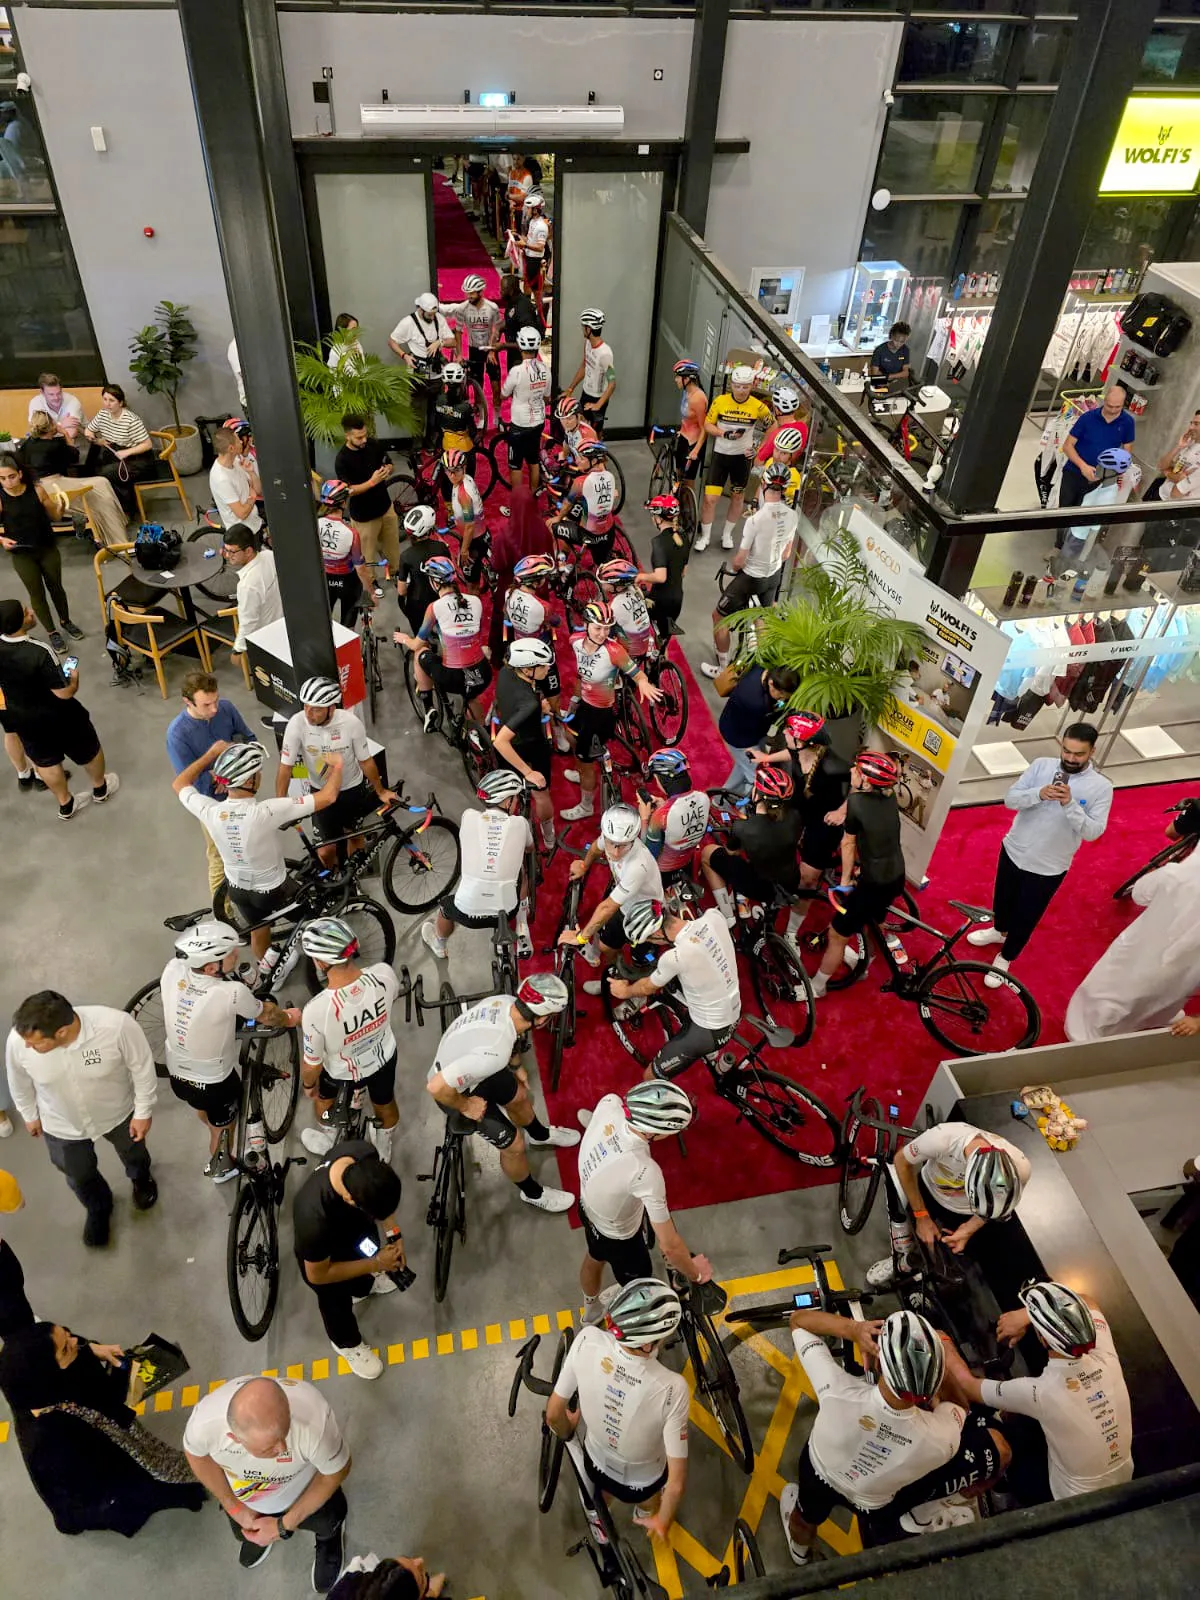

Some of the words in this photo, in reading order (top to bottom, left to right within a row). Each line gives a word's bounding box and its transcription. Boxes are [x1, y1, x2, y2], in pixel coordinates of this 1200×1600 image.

[1125, 148, 1192, 164] WOLFI'S
[468, 316, 488, 325] UAE
[529, 371, 547, 382] UAE
[594, 481, 611, 493] UAE
[868, 569, 903, 606] ANALYSIS
[940, 607, 978, 641] WOLFI'S
[681, 805, 705, 826] UAE
[356, 840, 385, 876] OLNAGO
[343, 996, 387, 1035] UAE
[82, 1049, 101, 1058] UAE
[945, 1469, 979, 1496] UAE
